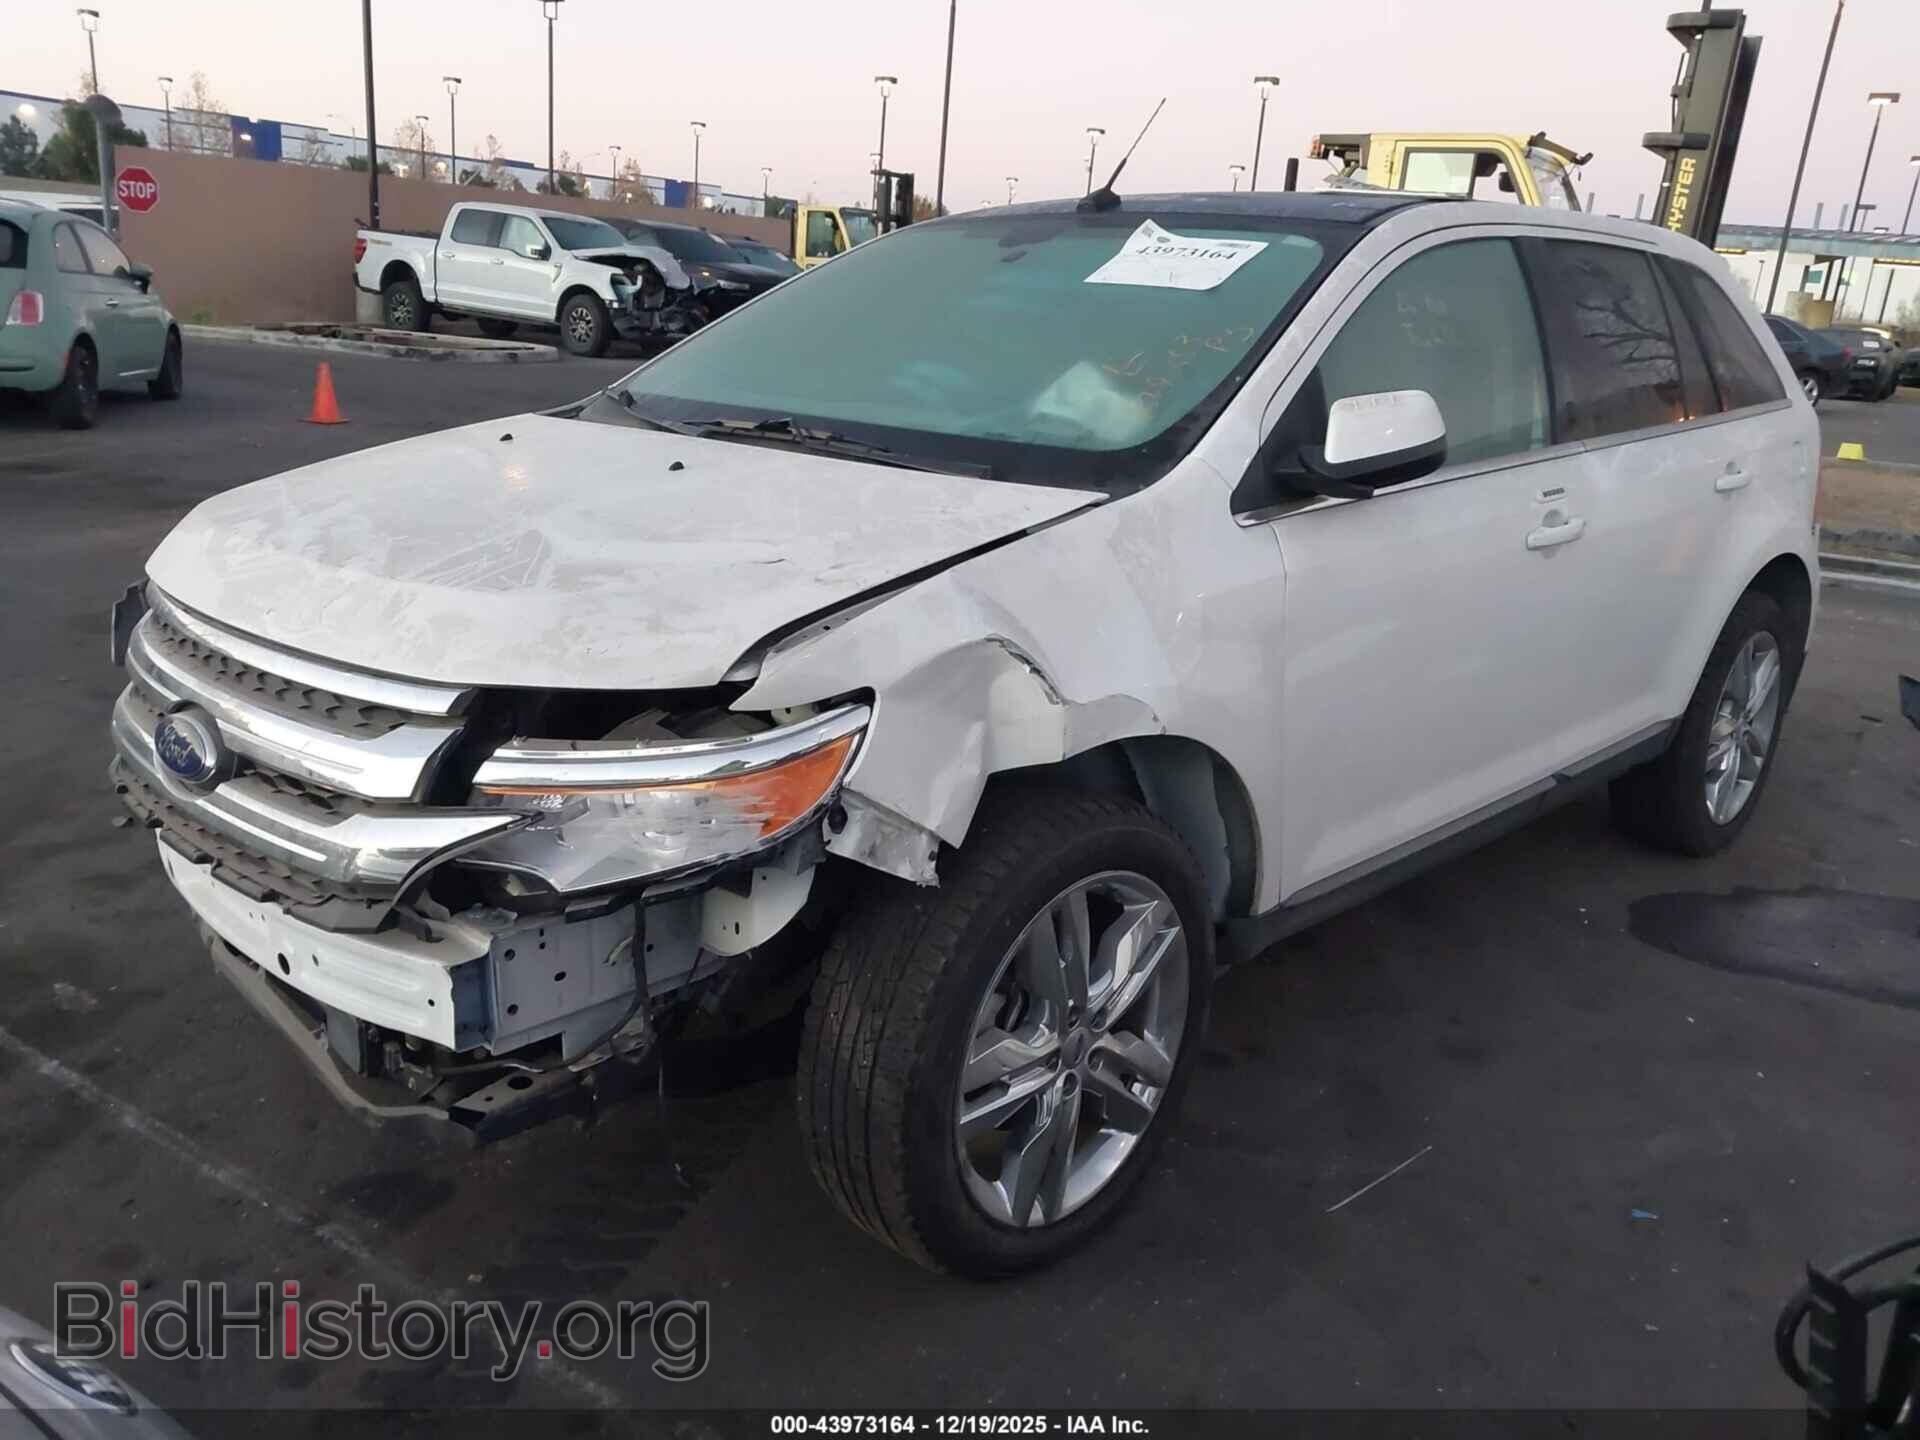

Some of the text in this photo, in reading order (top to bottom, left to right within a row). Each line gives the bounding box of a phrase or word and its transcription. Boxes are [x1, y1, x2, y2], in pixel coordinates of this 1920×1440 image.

[119, 180, 156, 198] STOP
[1136, 246, 1239, 260] 43973164
[158, 723, 194, 768] Ford
